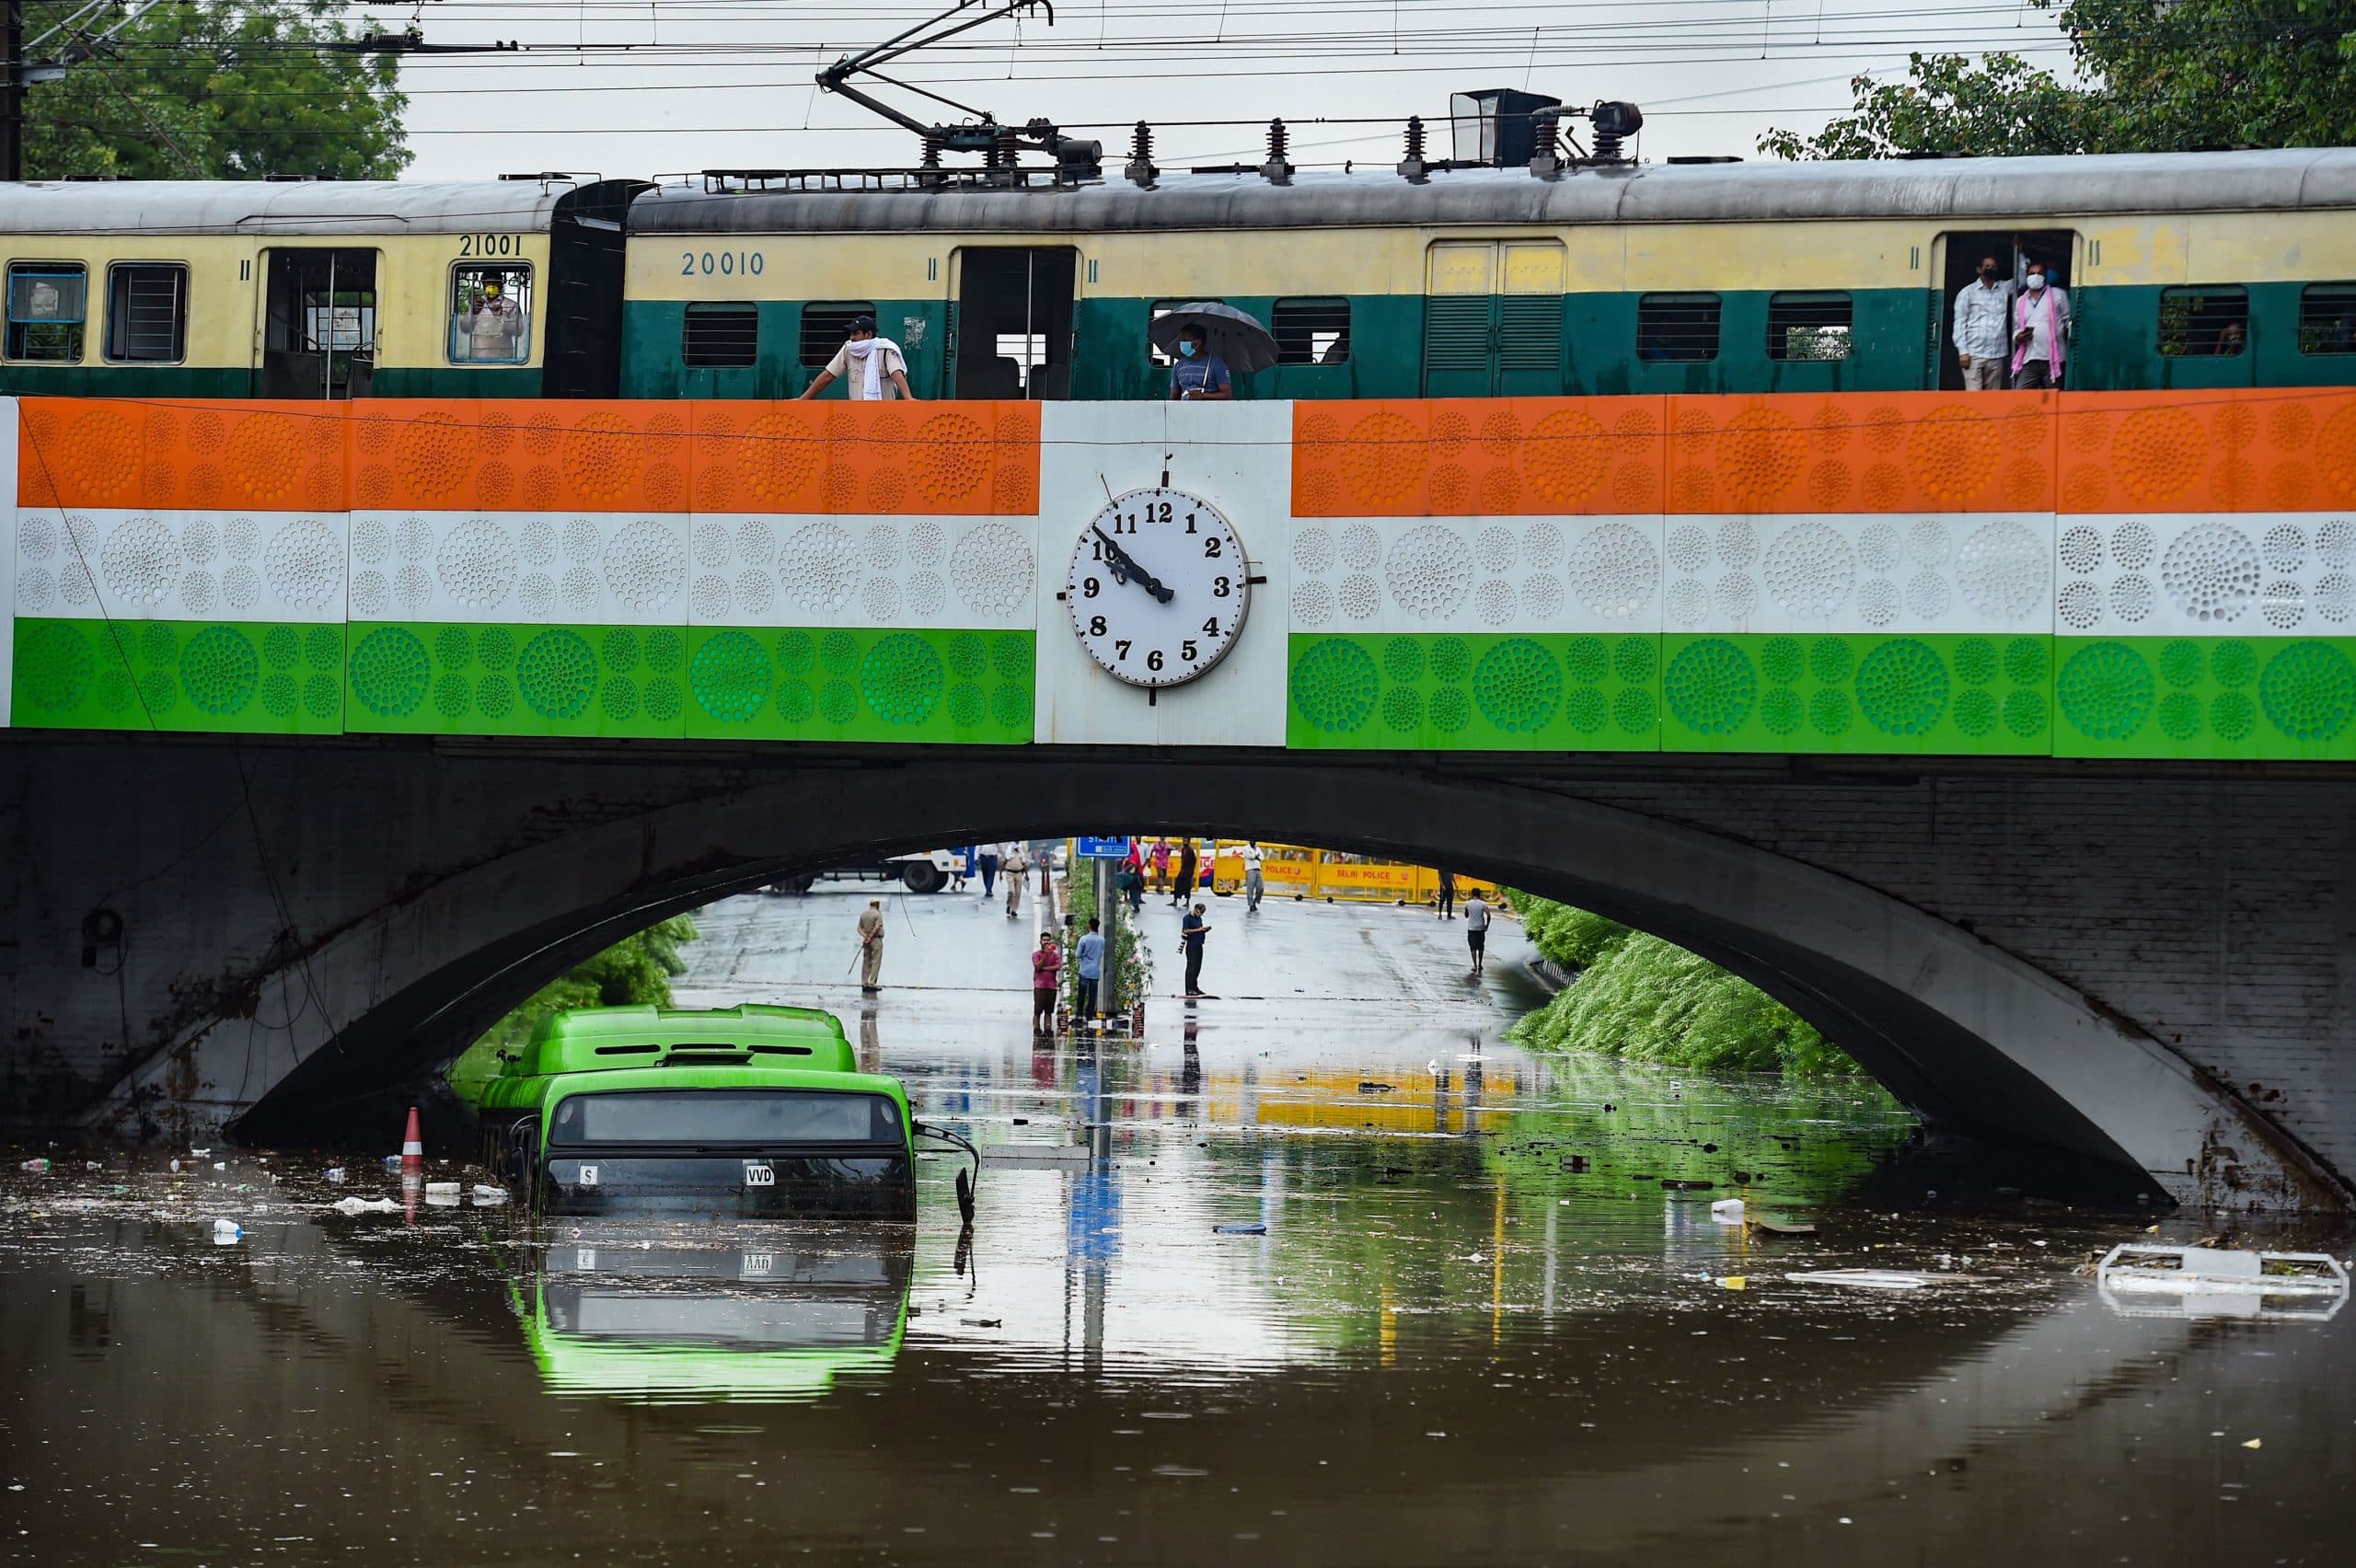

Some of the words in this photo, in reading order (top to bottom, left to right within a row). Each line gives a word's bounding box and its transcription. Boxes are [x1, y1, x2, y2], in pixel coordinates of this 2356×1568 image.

[459, 234, 521, 257] 21001
[681, 251, 765, 276] 20010
[1114, 513, 1138, 535] 11
[1146, 502, 1172, 524] 12
[1184, 513, 1197, 534] 1
[1205, 536, 1221, 559] 2
[1083, 577, 1100, 599] 9
[1213, 576, 1230, 598] 3
[1089, 615, 1107, 637] 8
[1202, 617, 1220, 638] 4
[1114, 640, 1132, 661] 7
[1147, 650, 1163, 672] 6
[1181, 640, 1197, 662] 5
[1265, 865, 1292, 875] POLICE
[1336, 869, 1357, 879] DELHI
[1362, 870, 1391, 880] POLICE
[583, 1169, 593, 1183] S
[748, 1169, 771, 1182] VVD
